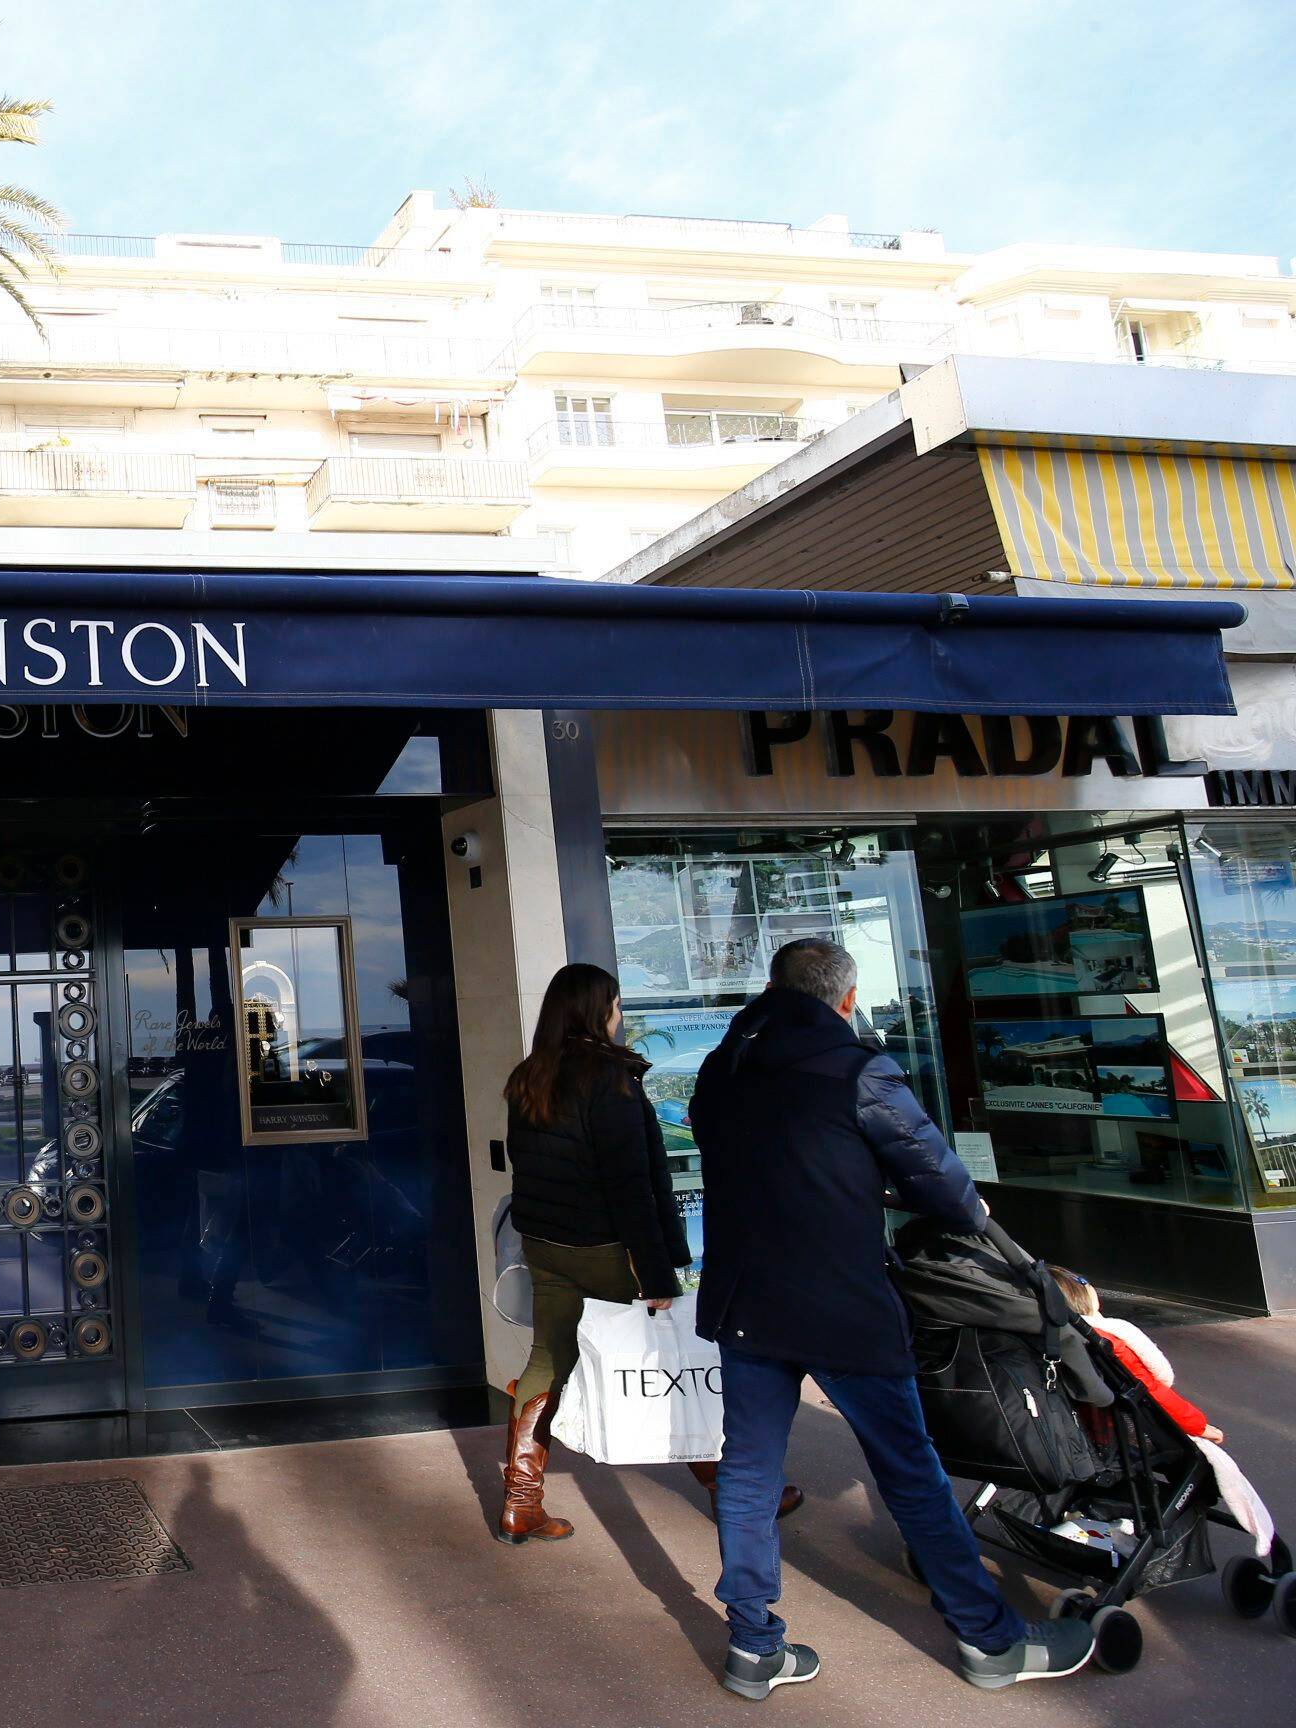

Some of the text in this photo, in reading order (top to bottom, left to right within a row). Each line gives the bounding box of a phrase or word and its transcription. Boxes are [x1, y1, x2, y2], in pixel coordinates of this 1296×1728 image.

[552, 720, 580, 740] 30
[739, 709, 1209, 777] PRADAL
[135, 1009, 221, 1037] Rare Jewels
[683, 1024, 700, 1032] MER
[185, 1029, 228, 1051] World
[985, 1100, 1102, 1111] EXCLUSIVITE CANNES "CALIFORNIE"
[259, 1113, 329, 1124] HARRY WINSTON
